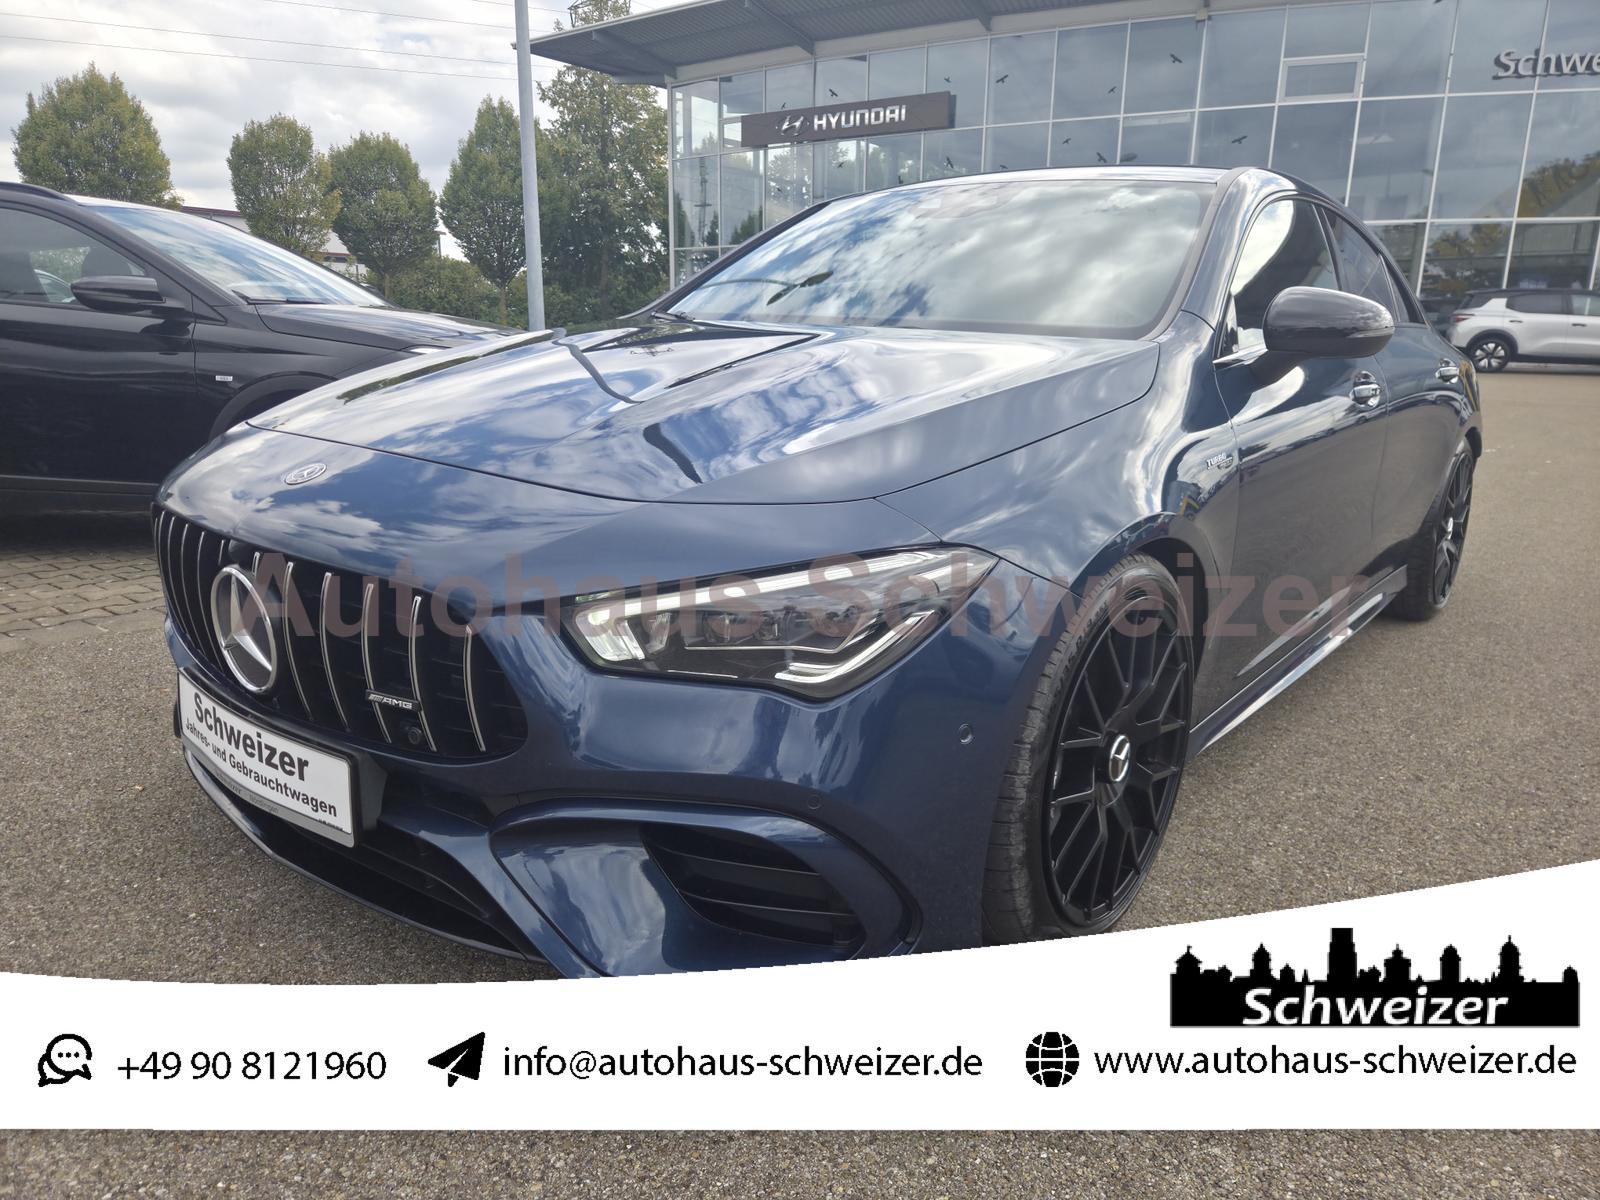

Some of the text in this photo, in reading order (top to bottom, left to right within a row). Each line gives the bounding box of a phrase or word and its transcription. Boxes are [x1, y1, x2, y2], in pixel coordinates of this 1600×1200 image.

[813, 104, 907, 132] HYUNDAI
[382, 697, 413, 710] AMG
[194, 692, 309, 782] Schweizer
[185, 717, 211, 748] Jahres-
[212, 743, 227, 764] und
[229, 754, 338, 818] Gebrauchtwagen
